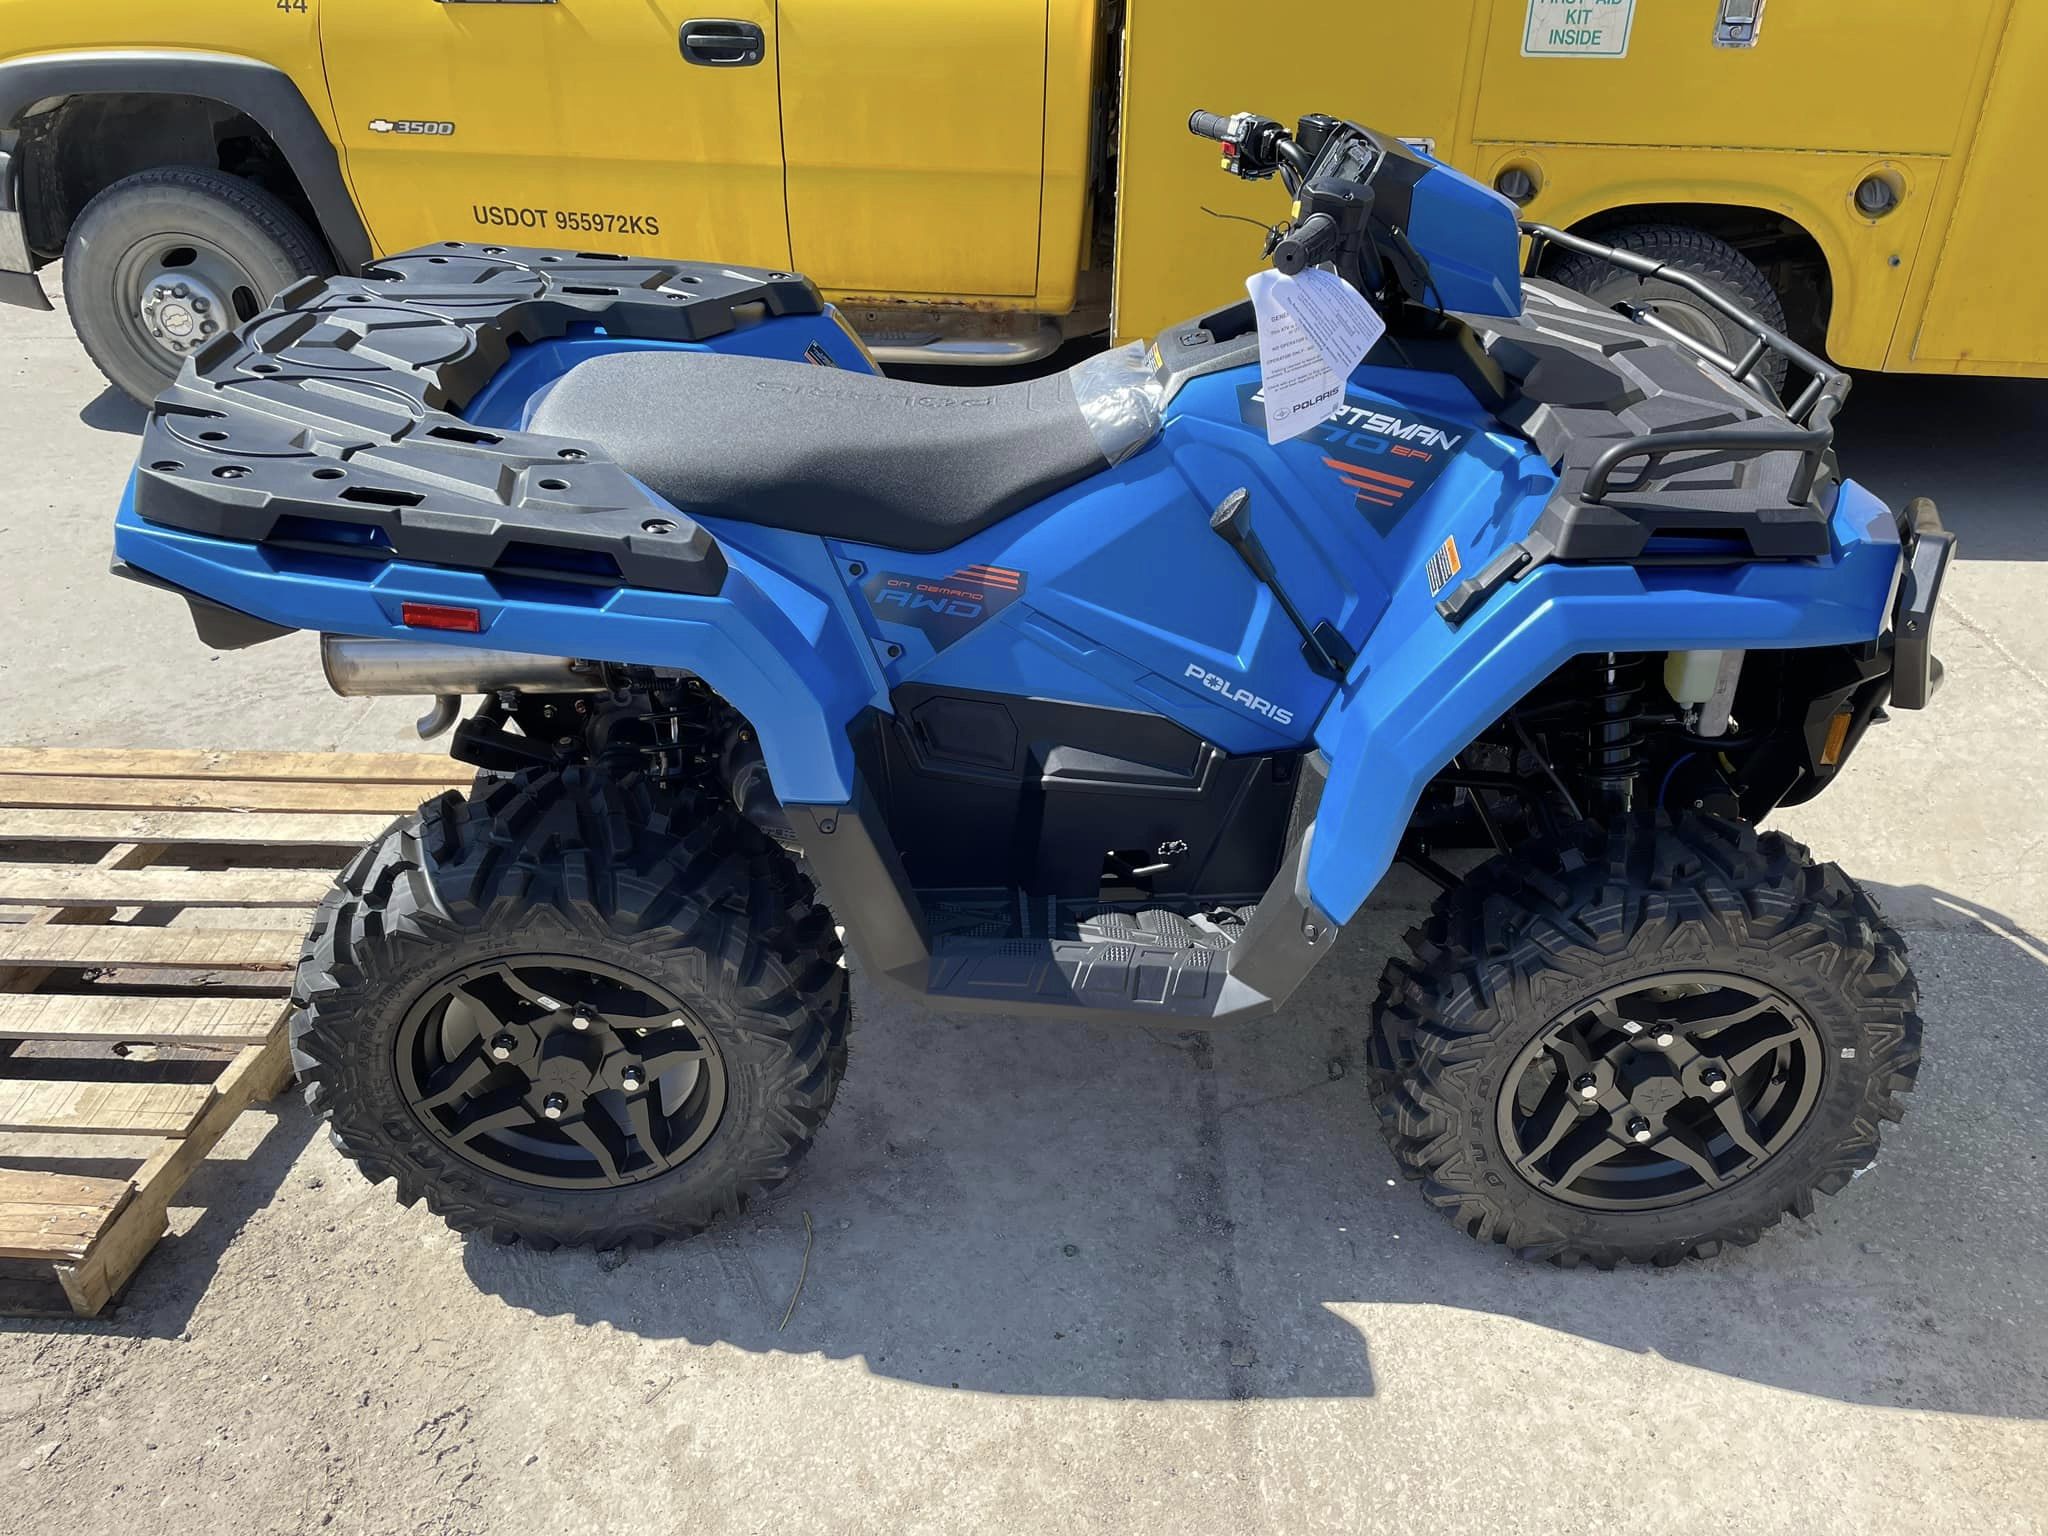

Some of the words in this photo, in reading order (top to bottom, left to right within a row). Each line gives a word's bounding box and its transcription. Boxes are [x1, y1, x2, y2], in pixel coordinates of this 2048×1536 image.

[1565, 9, 1593, 25] KIT
[1548, 29, 1603, 45] INSIDE
[397, 121, 454, 135] 3500
[473, 205, 548, 228] USDOT
[555, 211, 660, 236] 955972KS
[1292, 386, 1340, 413] POLARIS
[1391, 444, 1432, 462] EFI
[916, 584, 984, 600] DEMAND
[874, 589, 982, 618] AWD
[1184, 663, 1294, 725] POLARIS
